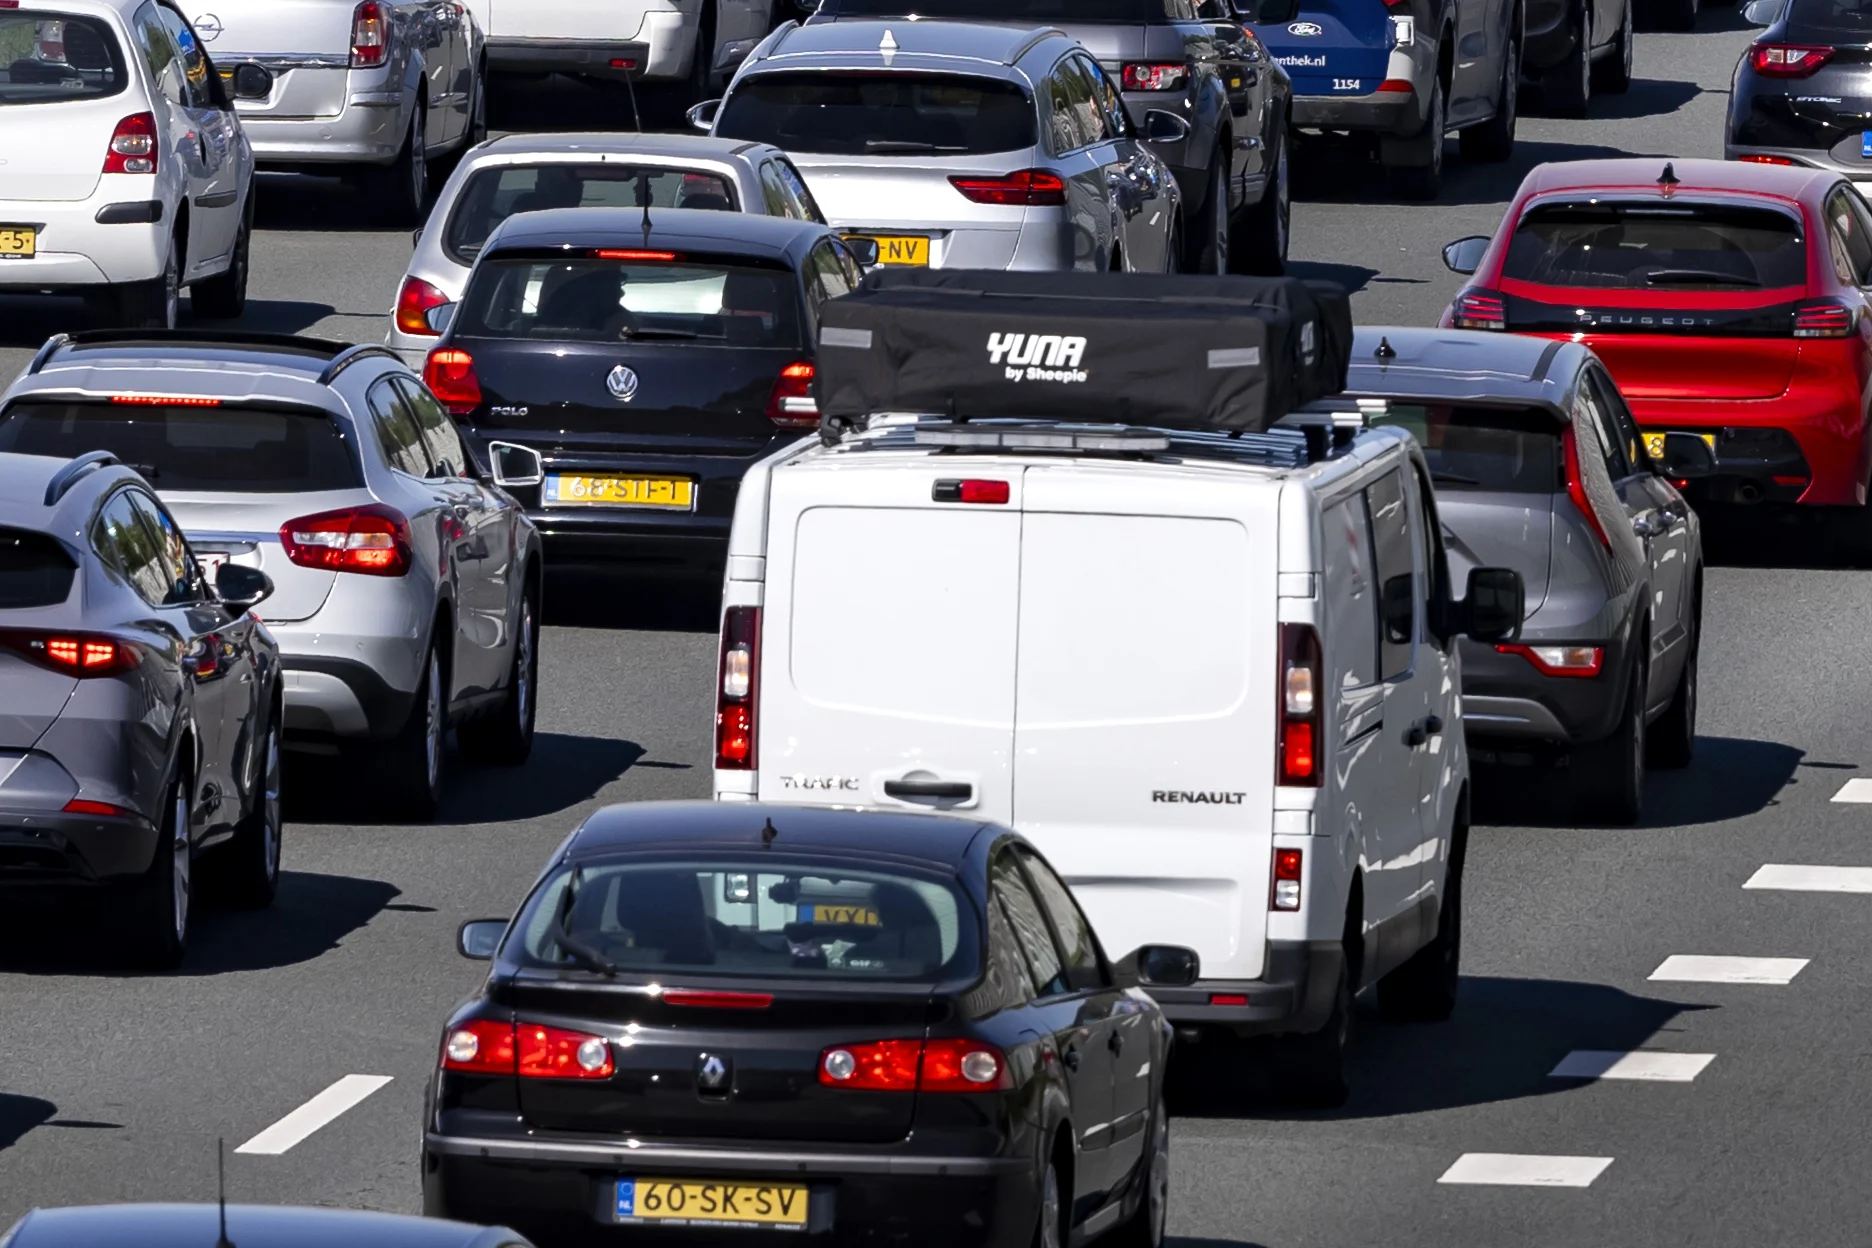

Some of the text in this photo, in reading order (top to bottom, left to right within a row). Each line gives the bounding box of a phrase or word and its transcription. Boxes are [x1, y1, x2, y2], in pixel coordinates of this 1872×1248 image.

[1332, 78, 1361, 90] 1154
[1579, 315, 1715, 326] PEUGEOT
[986, 332, 1088, 367] YUNA
[1005, 366, 1087, 383] by Sheepie
[490, 406, 528, 416] POLO
[570, 476, 678, 500] 68-STF-1
[779, 776, 860, 790] TRAFIC
[1151, 790, 1247, 805] RENAULT
[644, 1183, 798, 1217] 60-SK-SV
